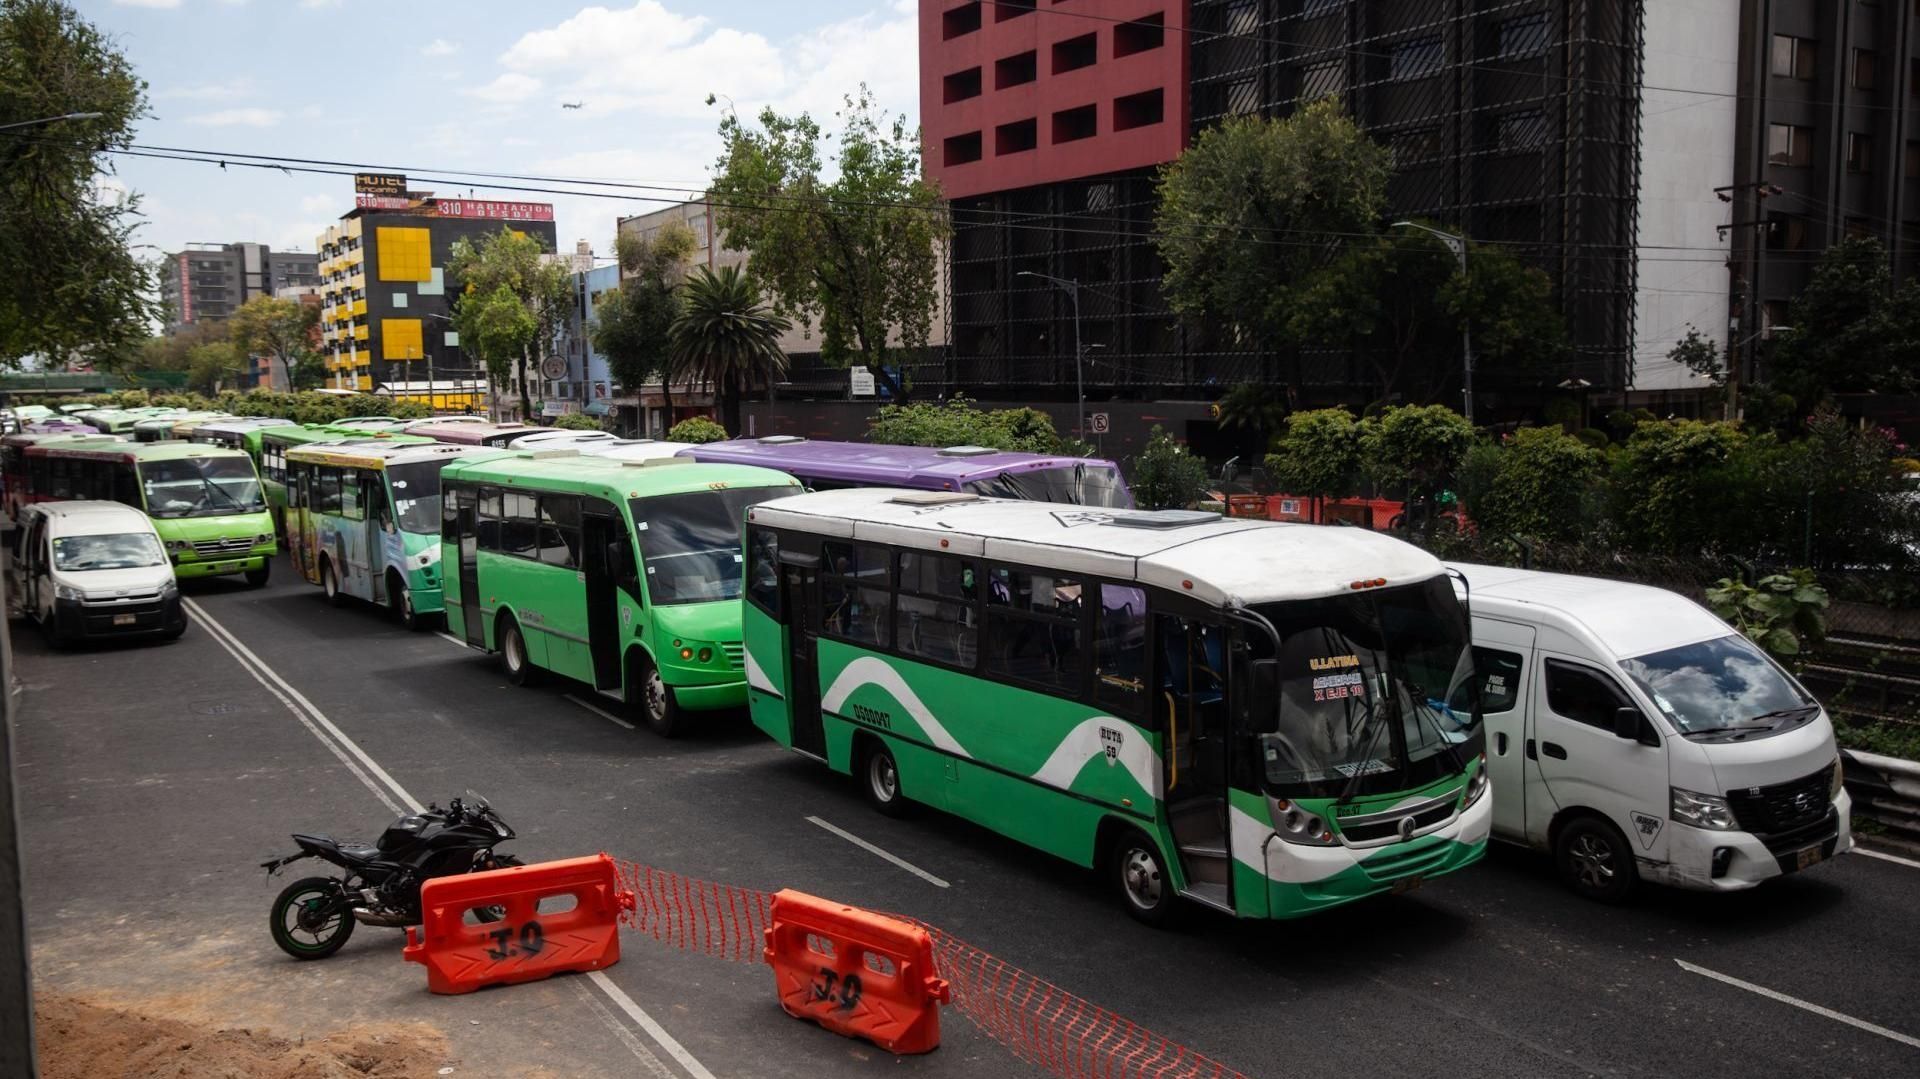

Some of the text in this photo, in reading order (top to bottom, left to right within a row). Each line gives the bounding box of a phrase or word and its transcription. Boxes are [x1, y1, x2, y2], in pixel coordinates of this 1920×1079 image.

[357, 185, 398, 194] Encanto
[438, 202, 461, 215] $310
[478, 209, 533, 218] DESDE
[1314, 684, 1364, 701] X EJE 10
[1101, 728, 1122, 744] RUTA
[1106, 745, 1117, 759] 59
